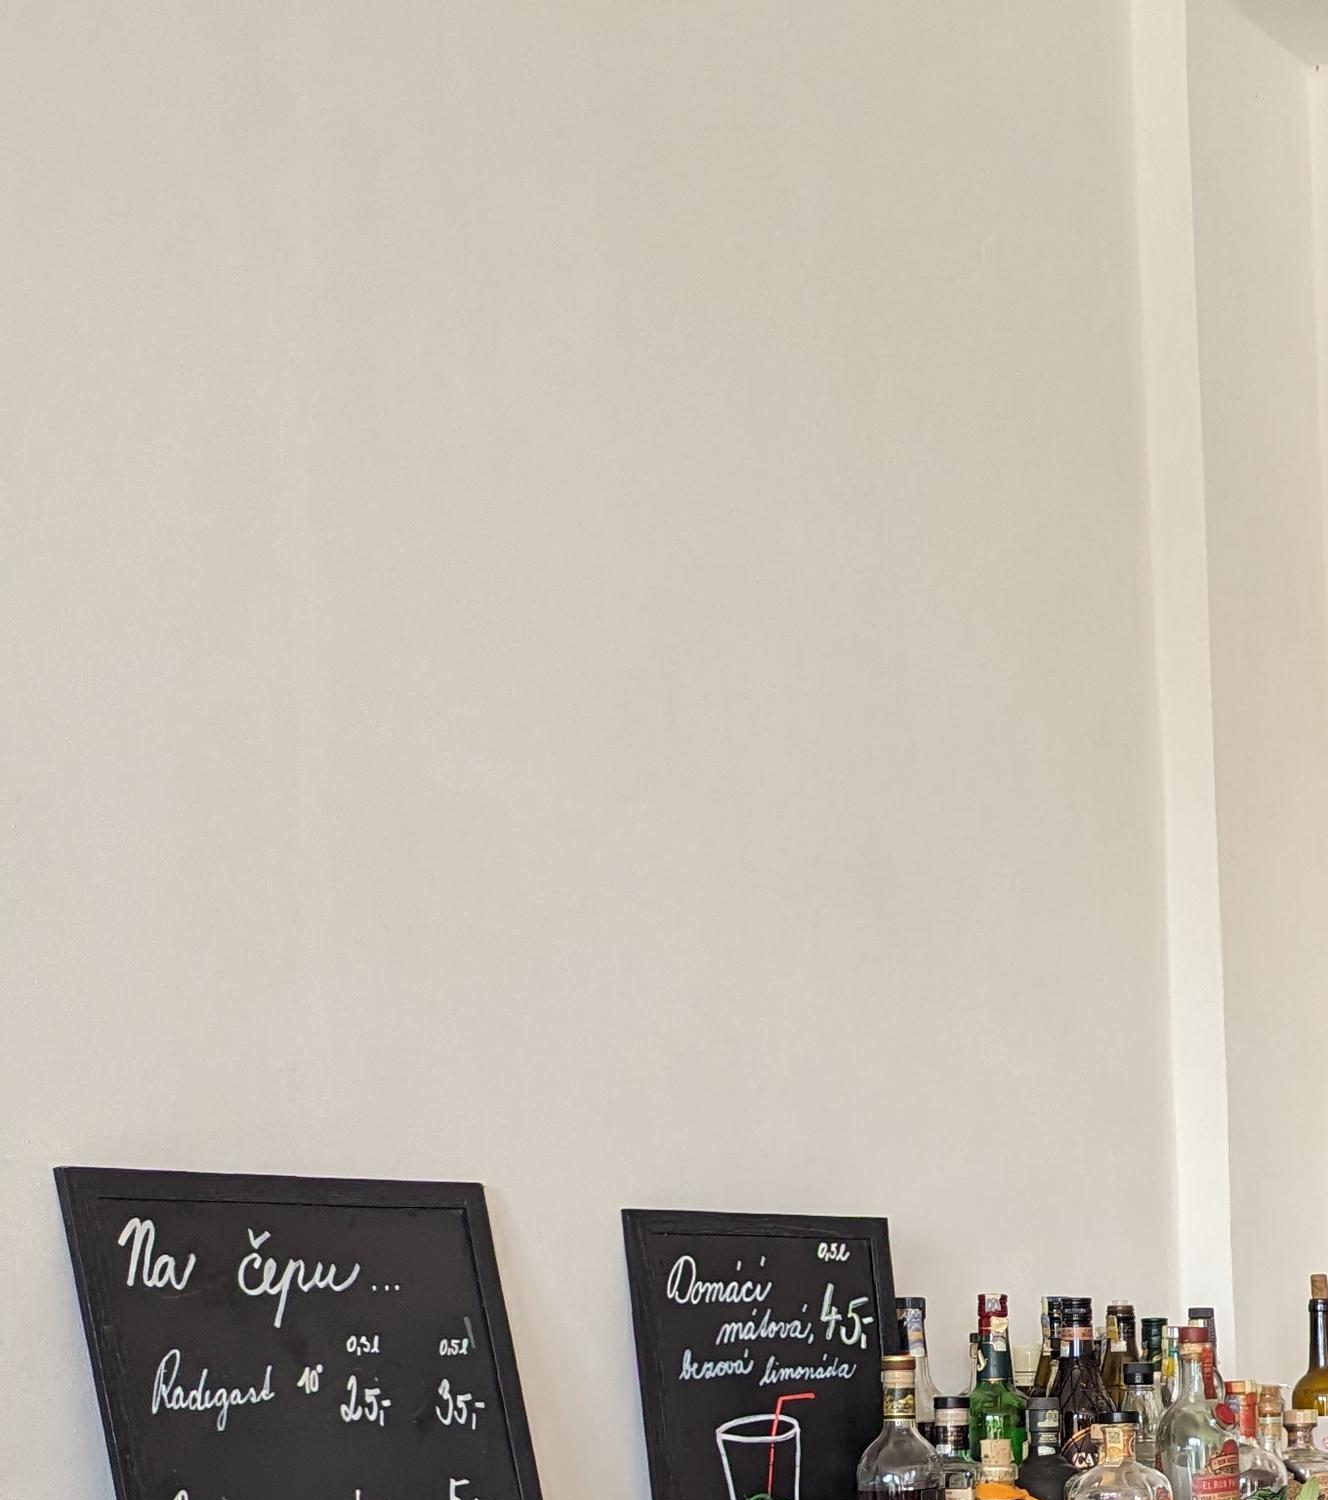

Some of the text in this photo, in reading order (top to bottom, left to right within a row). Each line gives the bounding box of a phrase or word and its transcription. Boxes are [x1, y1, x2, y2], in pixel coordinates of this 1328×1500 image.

[118, 1218, 196, 1290] Na
[667, 1255, 773, 1305] Domácí
[152, 1349, 275, 1431] Radegast
[679, 1349, 857, 1388] bezová limonáda
